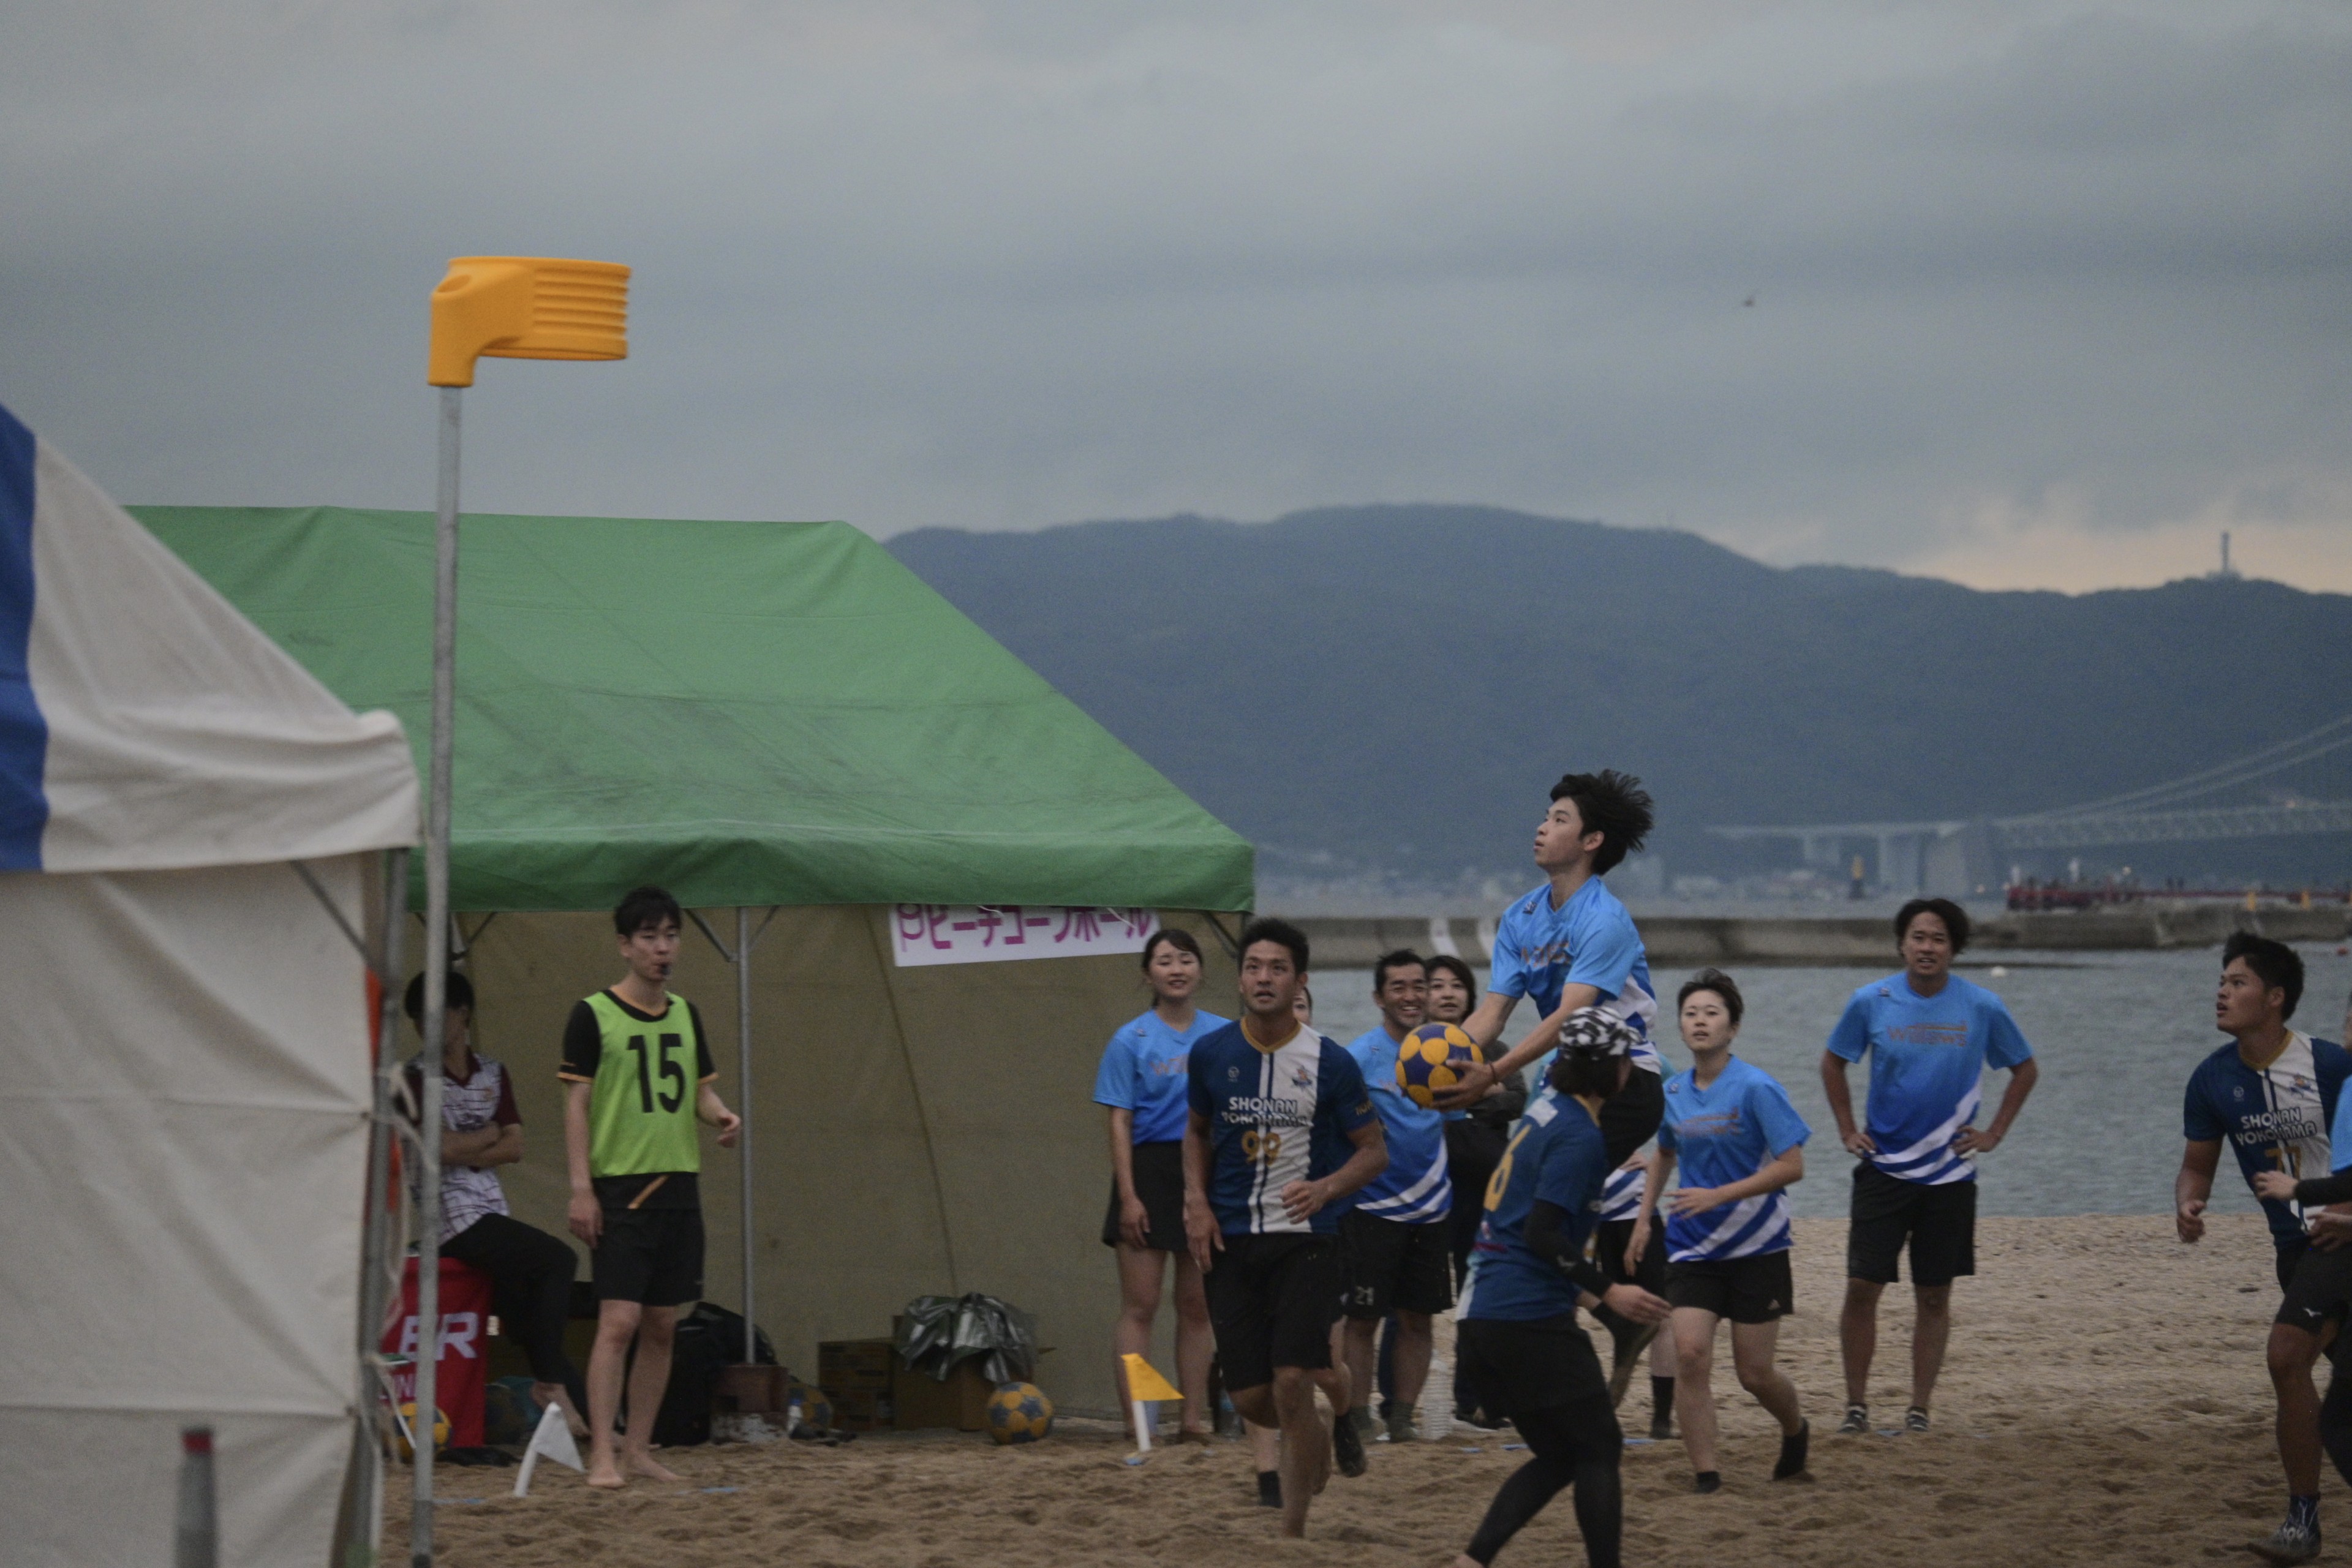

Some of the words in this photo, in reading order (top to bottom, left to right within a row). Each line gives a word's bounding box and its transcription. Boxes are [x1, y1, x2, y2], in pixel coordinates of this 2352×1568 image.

[627, 1033, 685, 1114] 15
[1229, 1096, 1298, 1116] SHONAN
[2241, 1107, 2302, 1129] SHONAN
[2235, 1120, 2317, 1146] YOKOHAMA
[1242, 1131, 1281, 1166] 99
